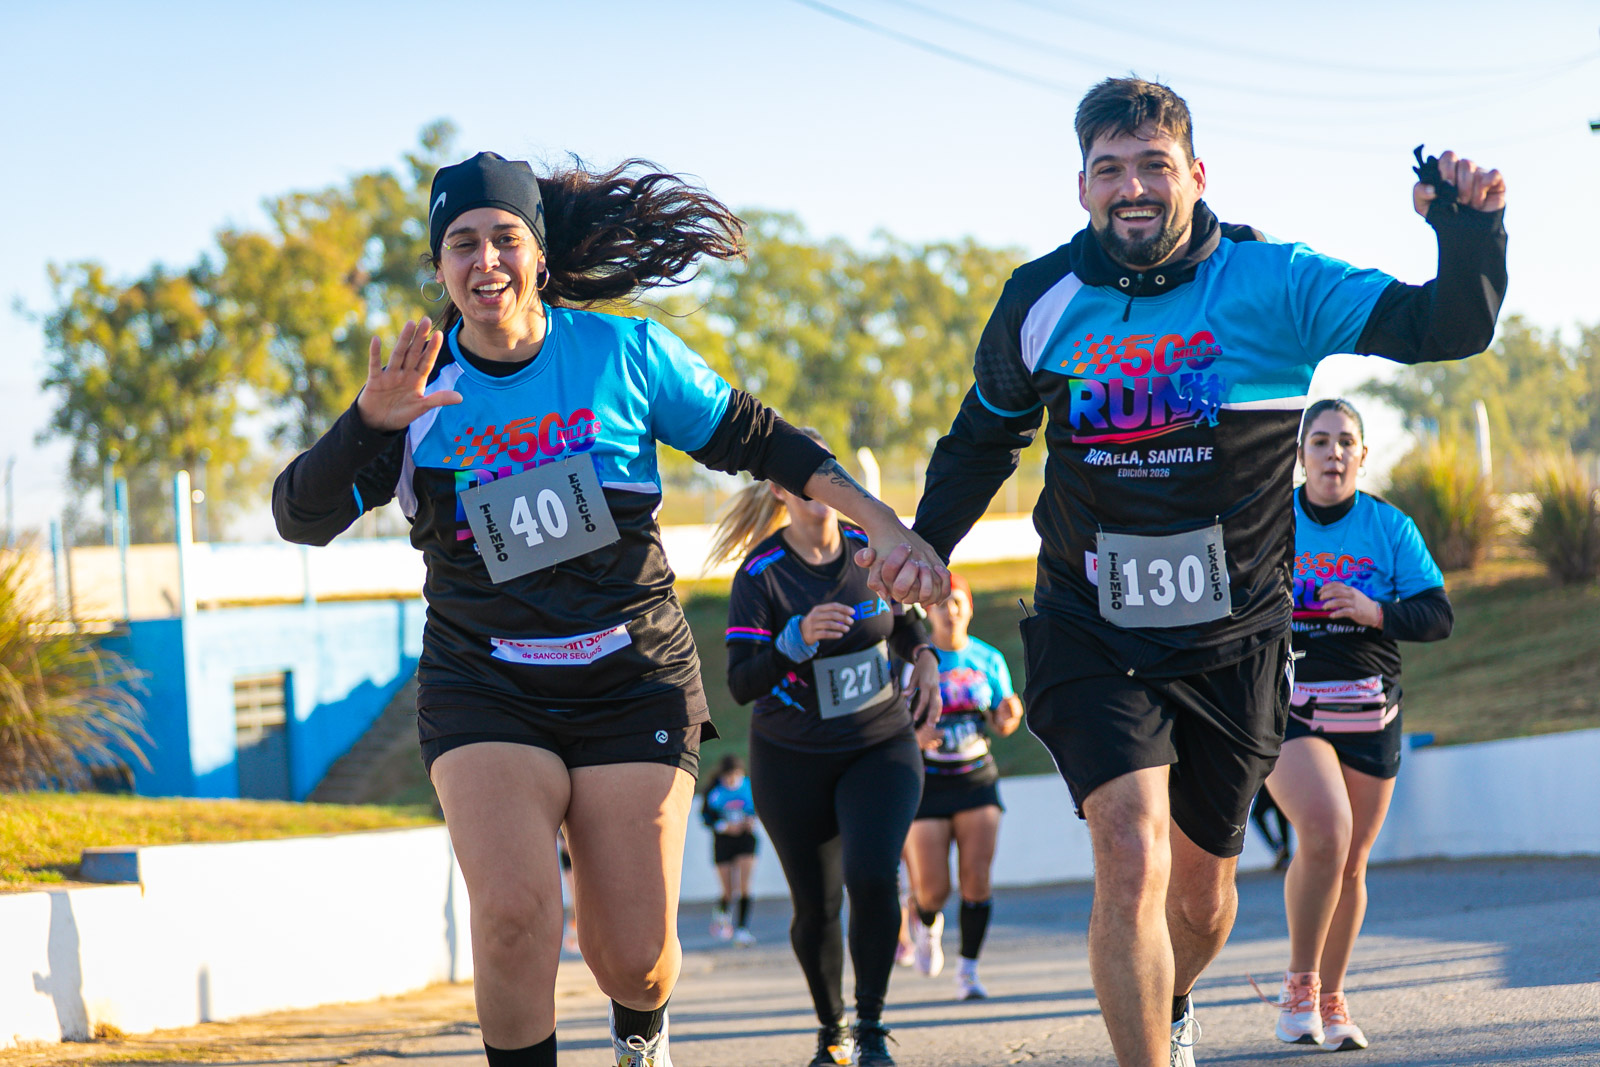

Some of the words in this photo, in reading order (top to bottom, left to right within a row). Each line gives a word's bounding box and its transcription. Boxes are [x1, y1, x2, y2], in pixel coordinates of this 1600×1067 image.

[1119, 331, 1216, 377] 500
[1173, 344, 1223, 361] MILLAS
[1068, 372, 1200, 430] RUN
[503, 408, 597, 463] 500
[556, 421, 602, 442] MILLAS
[1084, 448, 1144, 467] RAFAELA,
[1148, 449, 1193, 465] SANTA
[1197, 447, 1214, 462] FE
[1117, 467, 1148, 478] EDICIÓN
[1149, 468, 1170, 478] 2026
[509, 488, 569, 548] 40
[567, 472, 597, 533] EXACTO
[479, 502, 509, 563] TIEMPO
[1108, 551, 1123, 611] TIEMPO
[1122, 554, 1206, 607] 130
[1206, 542, 1224, 602] EXACTO
[532, 652, 568, 660] SANCOR
[569, 646, 603, 660] SEGUROS
[840, 660, 873, 701] 27
